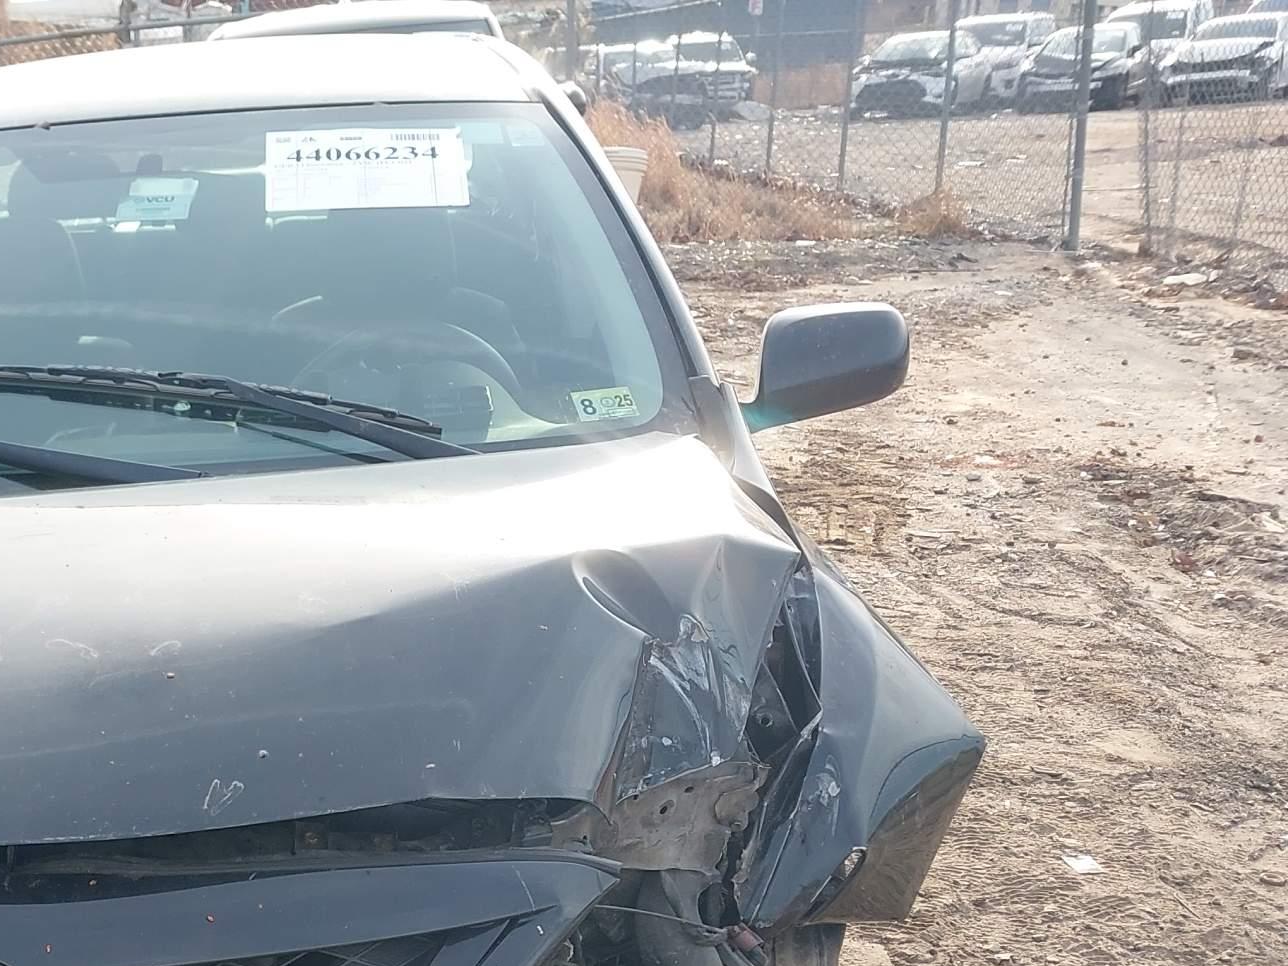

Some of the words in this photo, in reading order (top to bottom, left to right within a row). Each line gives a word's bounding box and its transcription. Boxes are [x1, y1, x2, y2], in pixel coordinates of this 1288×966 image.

[287, 146, 439, 162] 44066234
[145, 195, 176, 203] VCU
[580, 398, 597, 415] 8
[614, 394, 633, 407] 25
